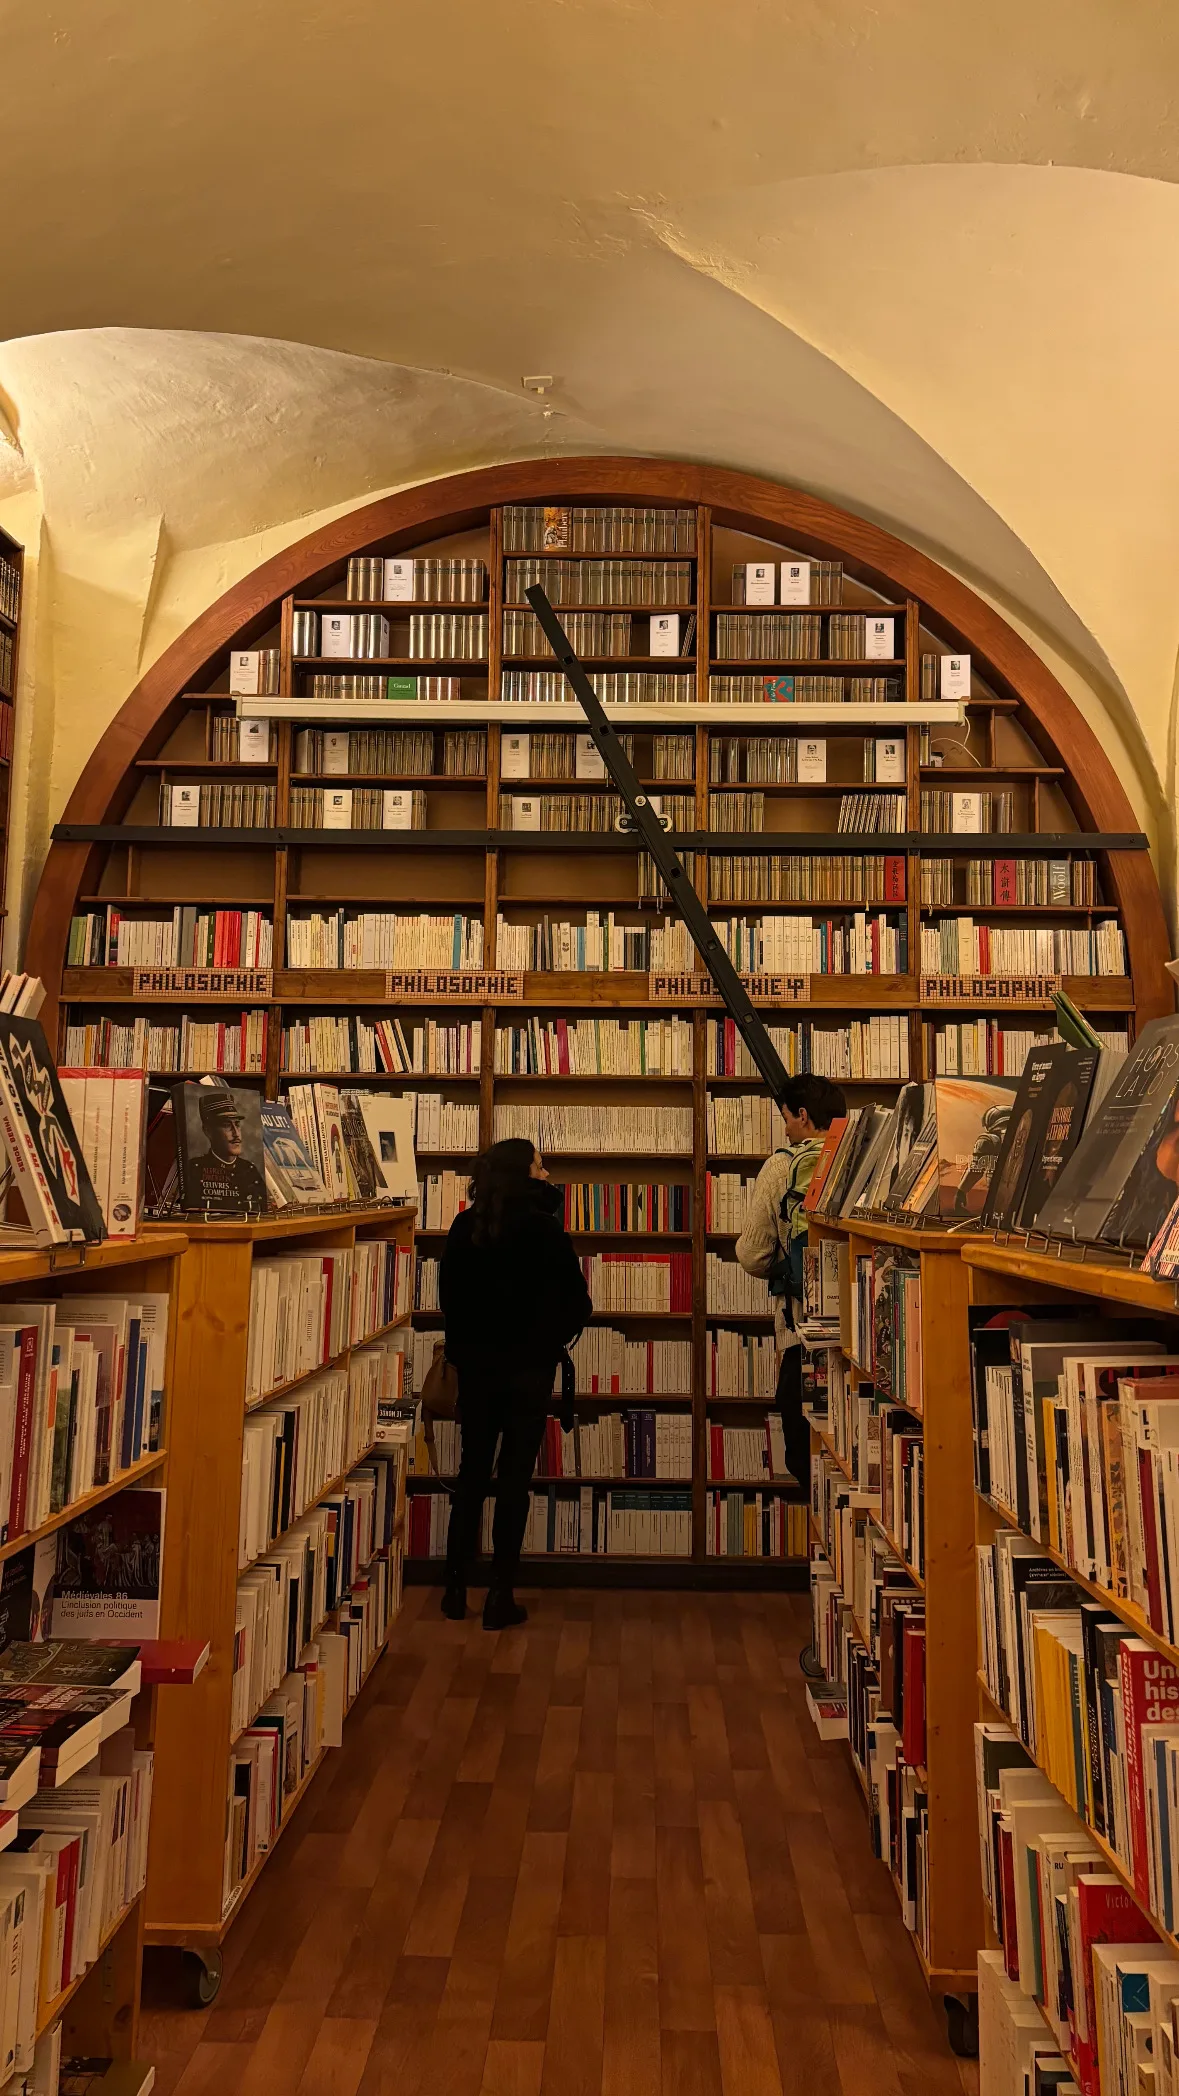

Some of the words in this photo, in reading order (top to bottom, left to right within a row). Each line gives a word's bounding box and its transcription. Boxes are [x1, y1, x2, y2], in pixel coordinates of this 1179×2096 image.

[139, 968, 267, 992] PHILOSOPHIE
[392, 969, 517, 994] PHILOSOPHIE
[655, 972, 782, 995] PHILOSPHIE
[62, 1590, 112, 1599] Médiévales
[62, 1601, 101, 1609] L'inclusion
[104, 1602, 137, 1610] politique
[108, 1610, 143, 1618] Occident
[1143, 1660, 1179, 1679] Un
